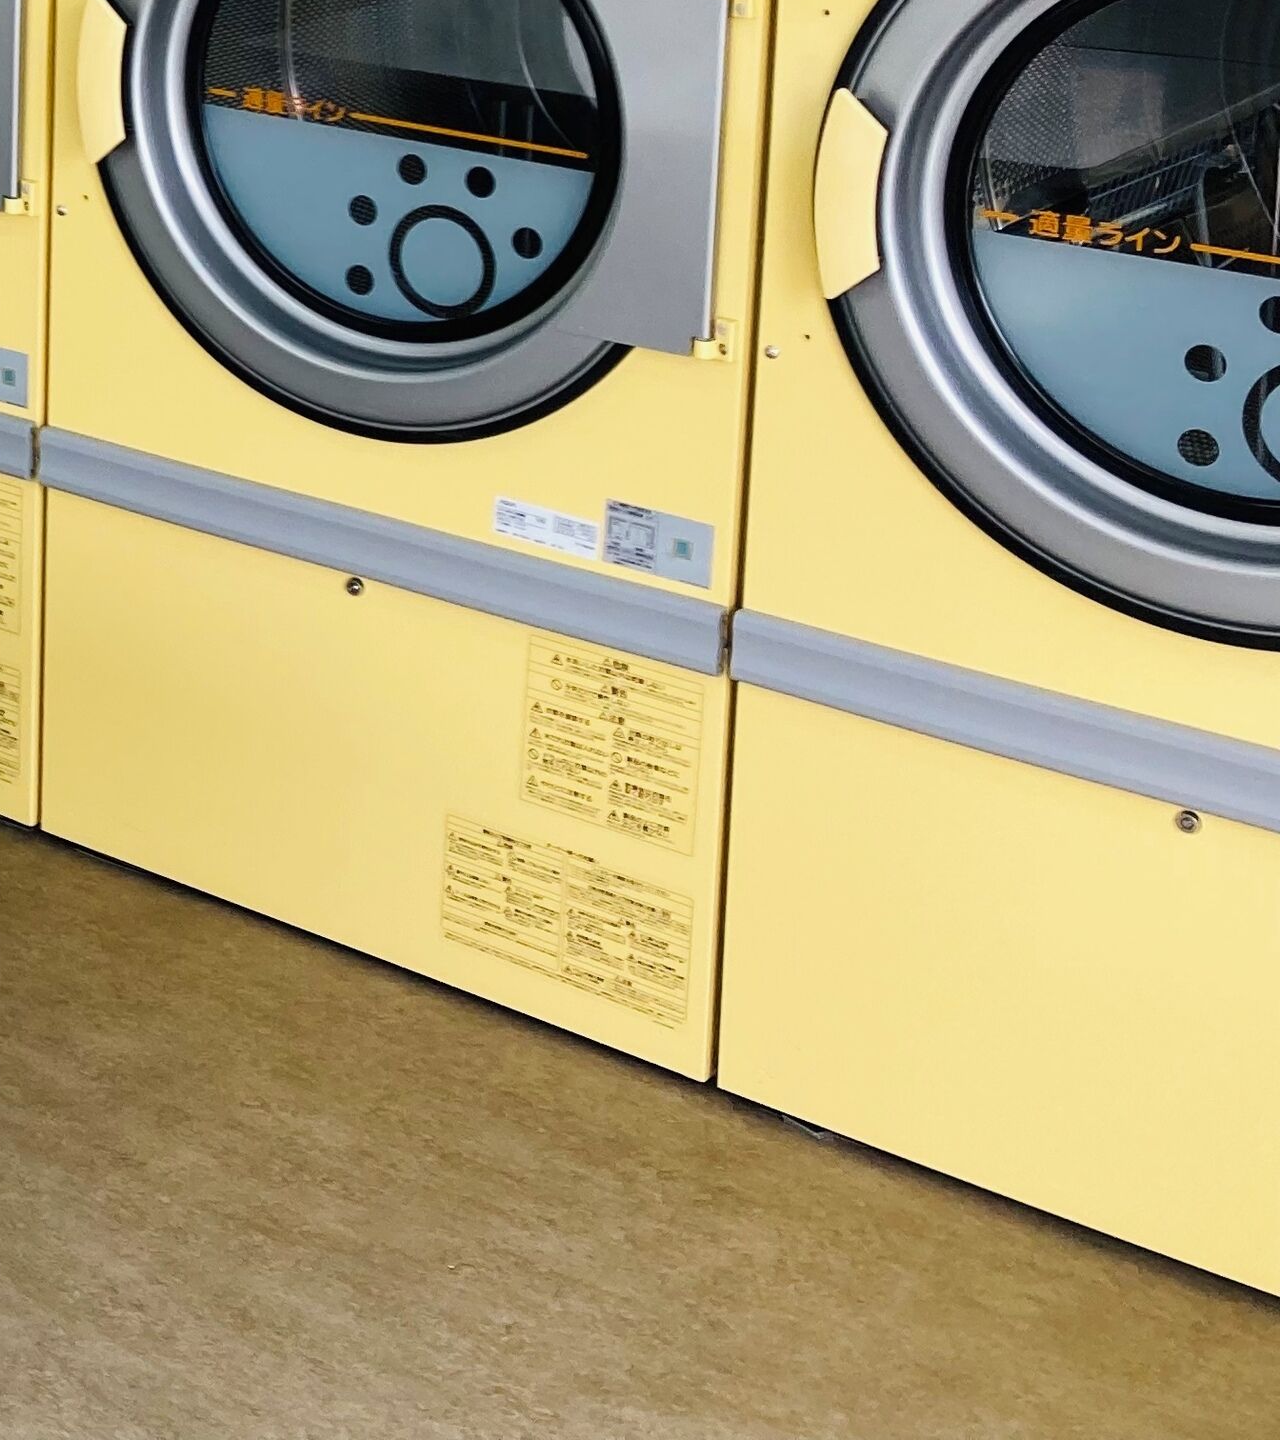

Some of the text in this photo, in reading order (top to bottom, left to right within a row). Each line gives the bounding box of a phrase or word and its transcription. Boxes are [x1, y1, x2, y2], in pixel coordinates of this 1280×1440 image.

[1029, 210, 1181, 254] 適量ライン
